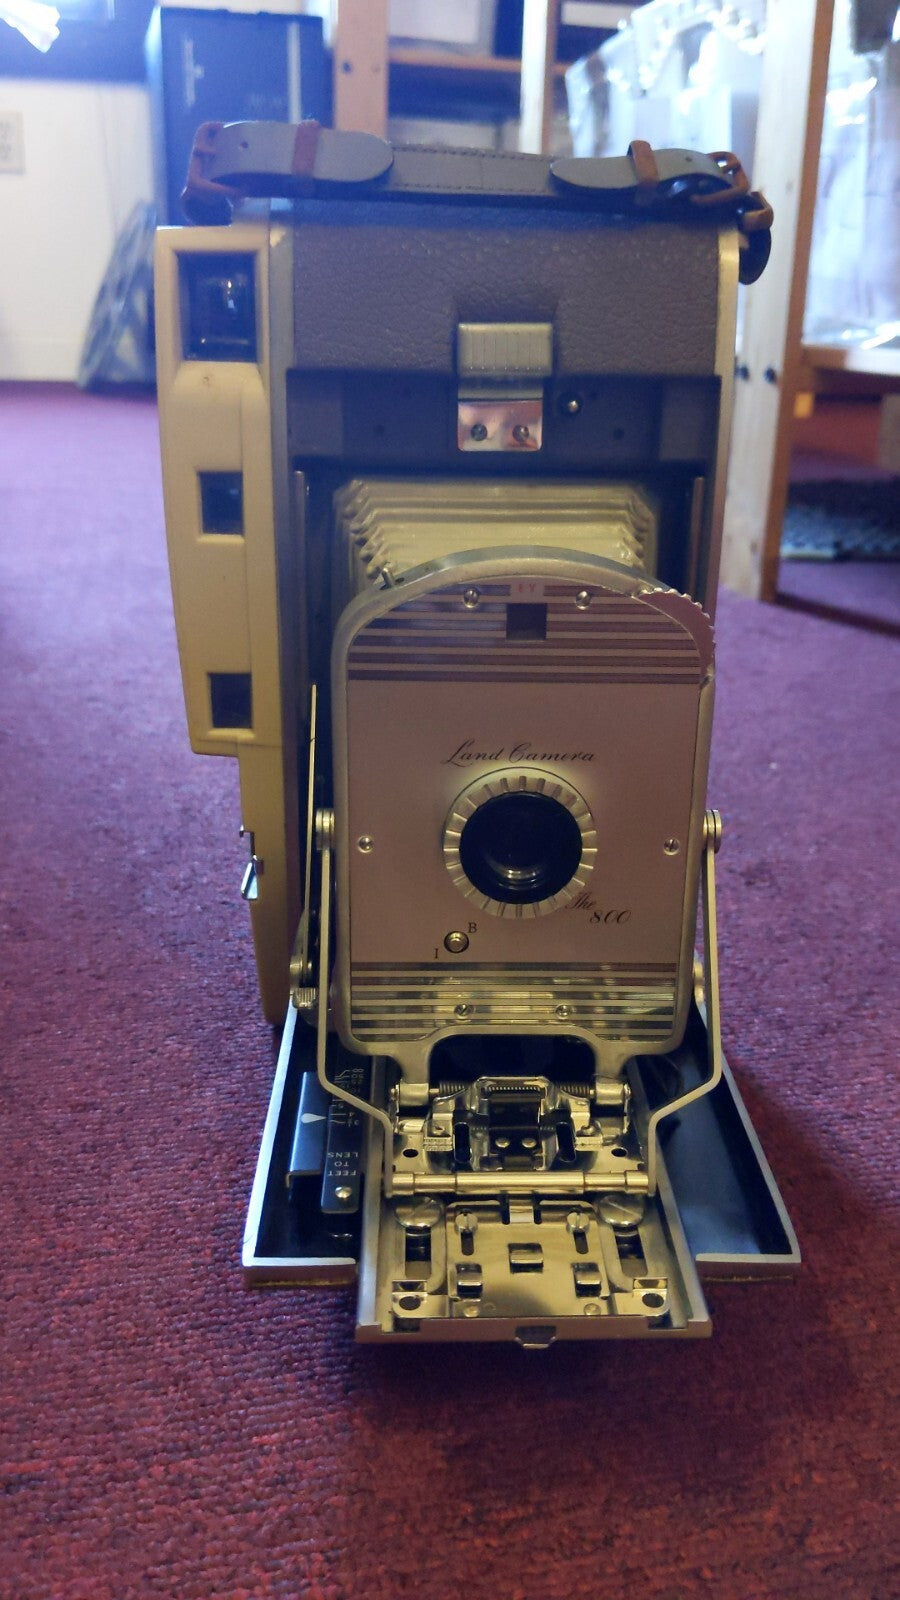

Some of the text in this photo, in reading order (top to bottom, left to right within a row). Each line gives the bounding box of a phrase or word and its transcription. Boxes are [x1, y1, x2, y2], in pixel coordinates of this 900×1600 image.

[442, 738, 595, 767] Land Camera
[564, 891, 595, 911] The
[589, 909, 632, 925] 800
[468, 921, 478, 934] B
